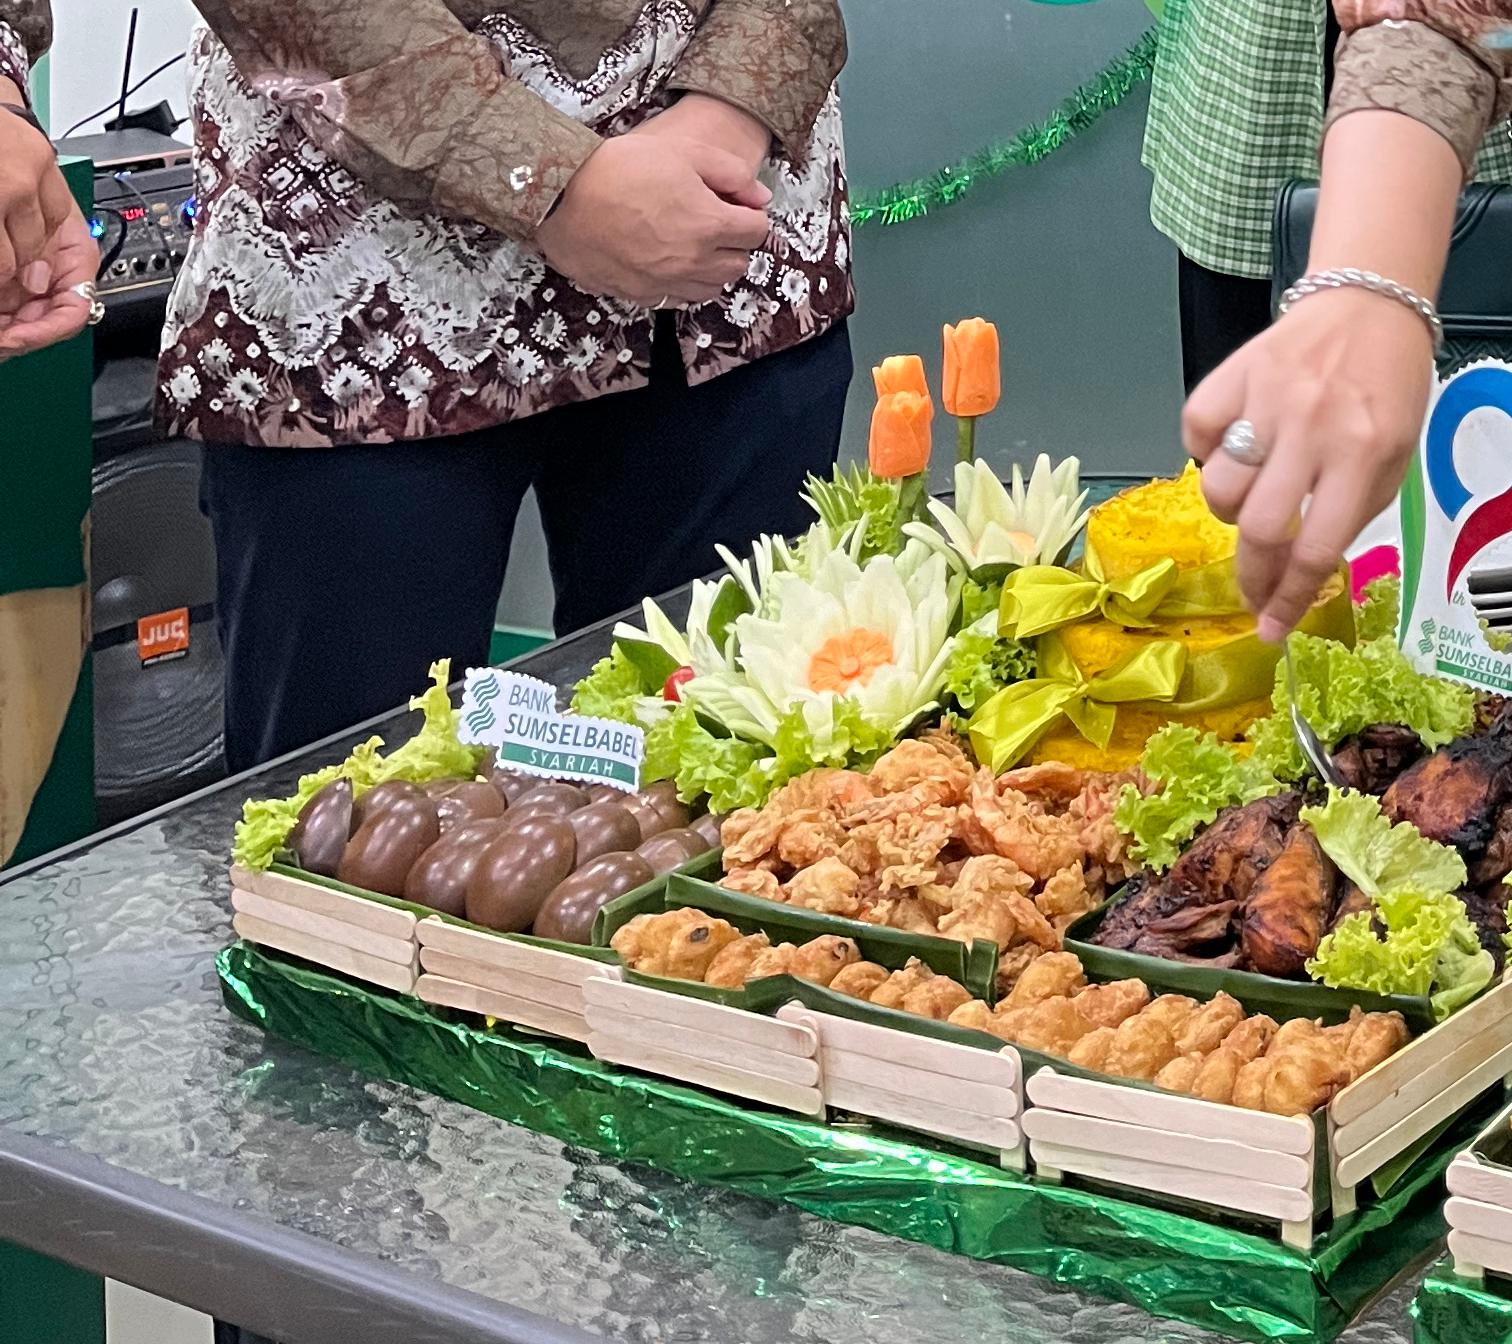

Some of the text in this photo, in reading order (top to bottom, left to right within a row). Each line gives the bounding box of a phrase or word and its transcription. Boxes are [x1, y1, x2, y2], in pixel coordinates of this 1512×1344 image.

[1438, 625, 1476, 649] BANK
[508, 684, 553, 715] BANK
[504, 713, 637, 760] SUMSELBABEL
[529, 748, 614, 777] SYARIAH
